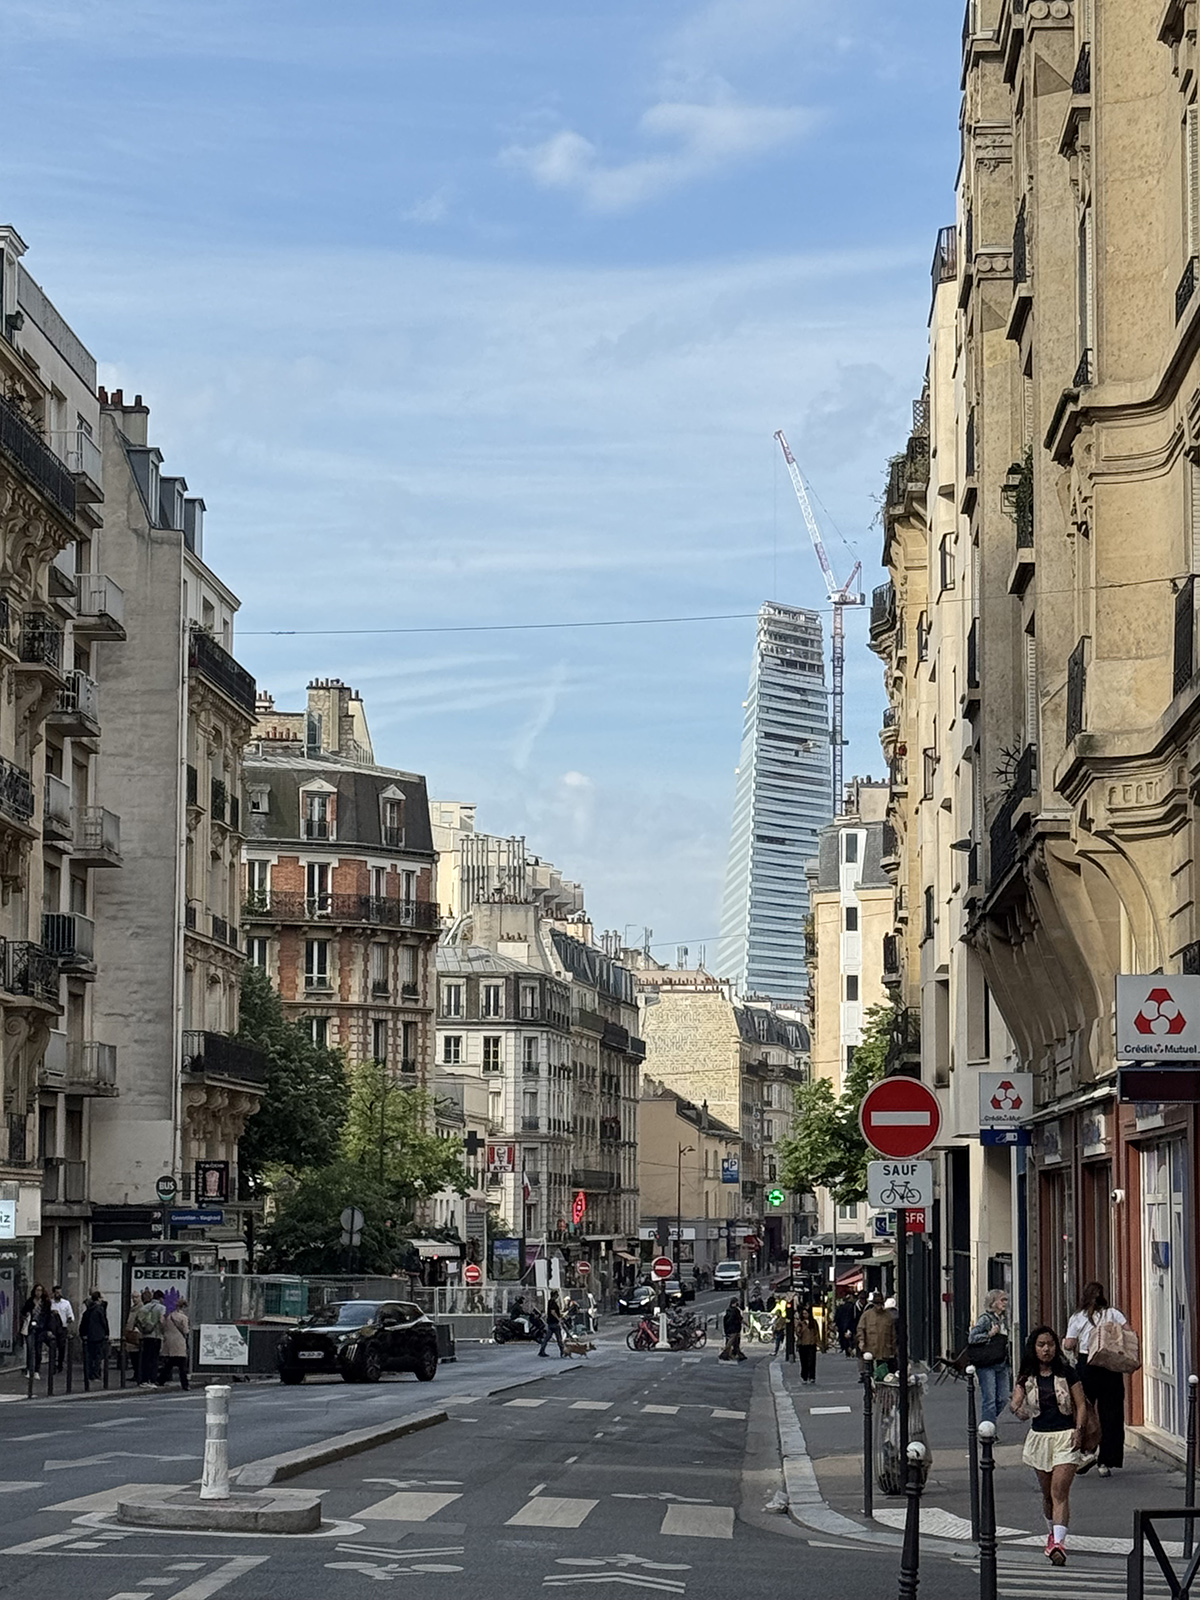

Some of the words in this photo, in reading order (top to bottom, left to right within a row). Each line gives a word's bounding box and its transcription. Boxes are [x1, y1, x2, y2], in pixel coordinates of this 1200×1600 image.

[1124, 1044, 1153, 1054] Crédit
[1164, 1044, 1197, 1054] Mutuel
[883, 1164, 918, 1176] SAUF
[158, 1181, 174, 1190] BUS
[134, 1269, 187, 1280] DEEZER
